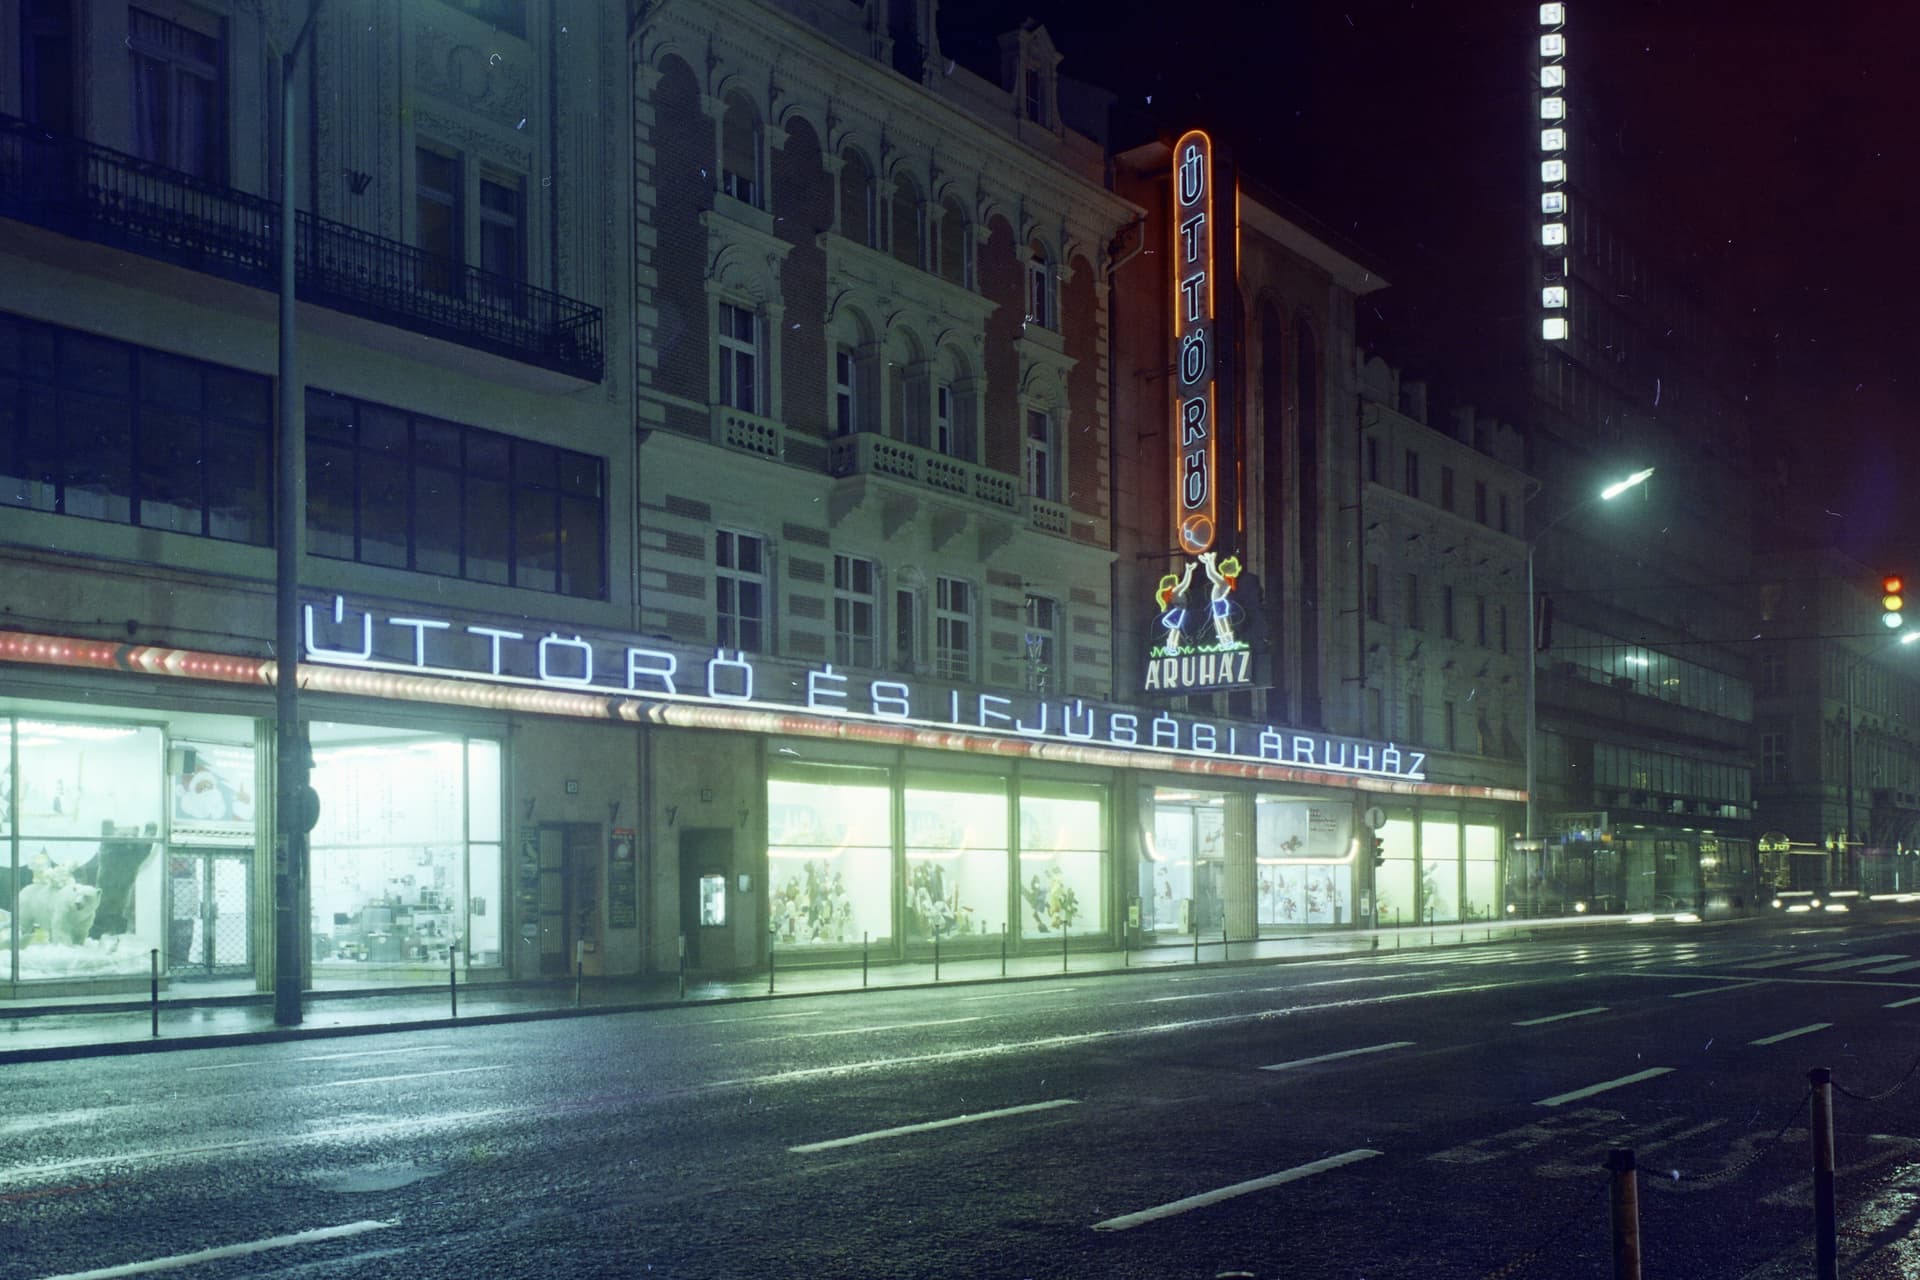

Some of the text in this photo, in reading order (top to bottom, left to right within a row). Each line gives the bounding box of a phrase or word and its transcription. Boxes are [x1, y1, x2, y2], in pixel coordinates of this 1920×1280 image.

[1540, 2, 1564, 308] HUNGAROTX
[304, 595, 1427, 777] ÚTTÖRŐ ÉS IFJÚSÁGI ÁRUHÁZ
